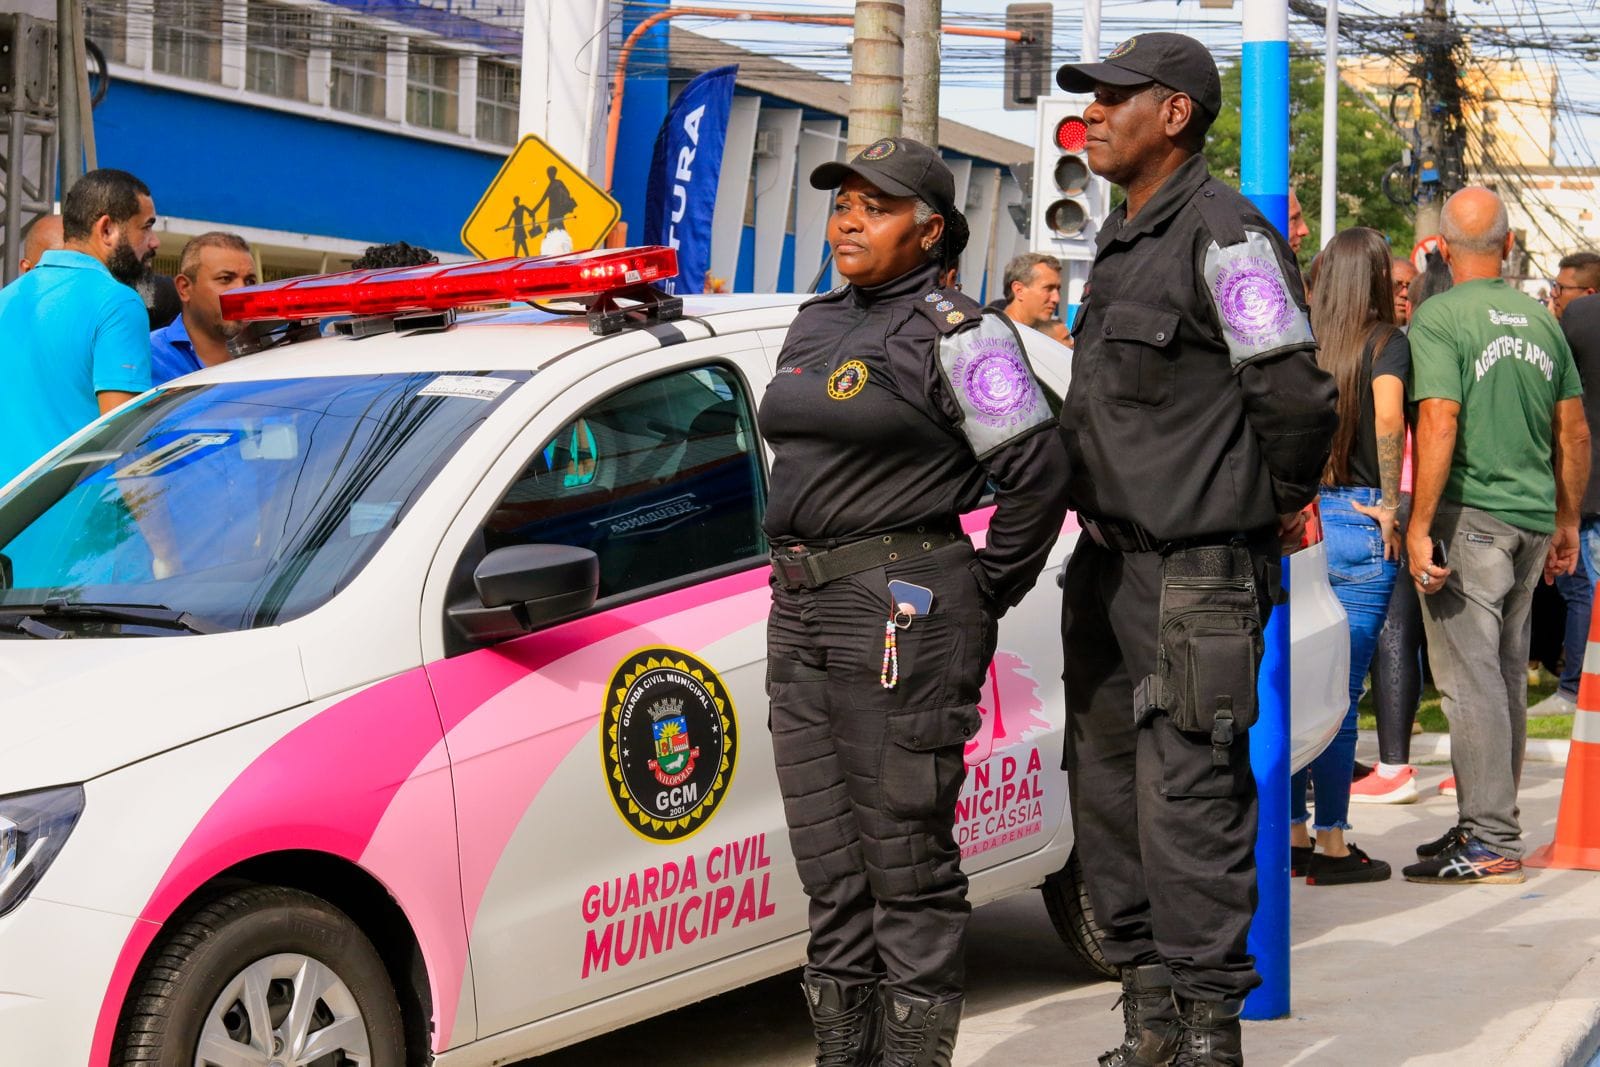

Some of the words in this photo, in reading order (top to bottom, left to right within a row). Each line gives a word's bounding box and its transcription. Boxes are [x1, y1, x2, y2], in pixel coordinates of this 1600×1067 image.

[1524, 341, 1554, 381] APOIO
[623, 686, 645, 727] GUARDA
[642, 674, 666, 689] CIVIL
[666, 673, 710, 710] MUNICIPAL
[655, 782, 698, 811] GCM
[669, 804, 686, 817] 2001
[954, 774, 1044, 825] NICIPAL
[958, 821, 980, 846] DE
[985, 800, 1042, 836] CÁSSIA
[982, 839, 998, 852] DA
[1001, 821, 1041, 845] PENHA
[582, 854, 698, 924] GUARDA
[706, 832, 771, 884] CIVIL
[581, 871, 777, 980] MUNICIPAL
